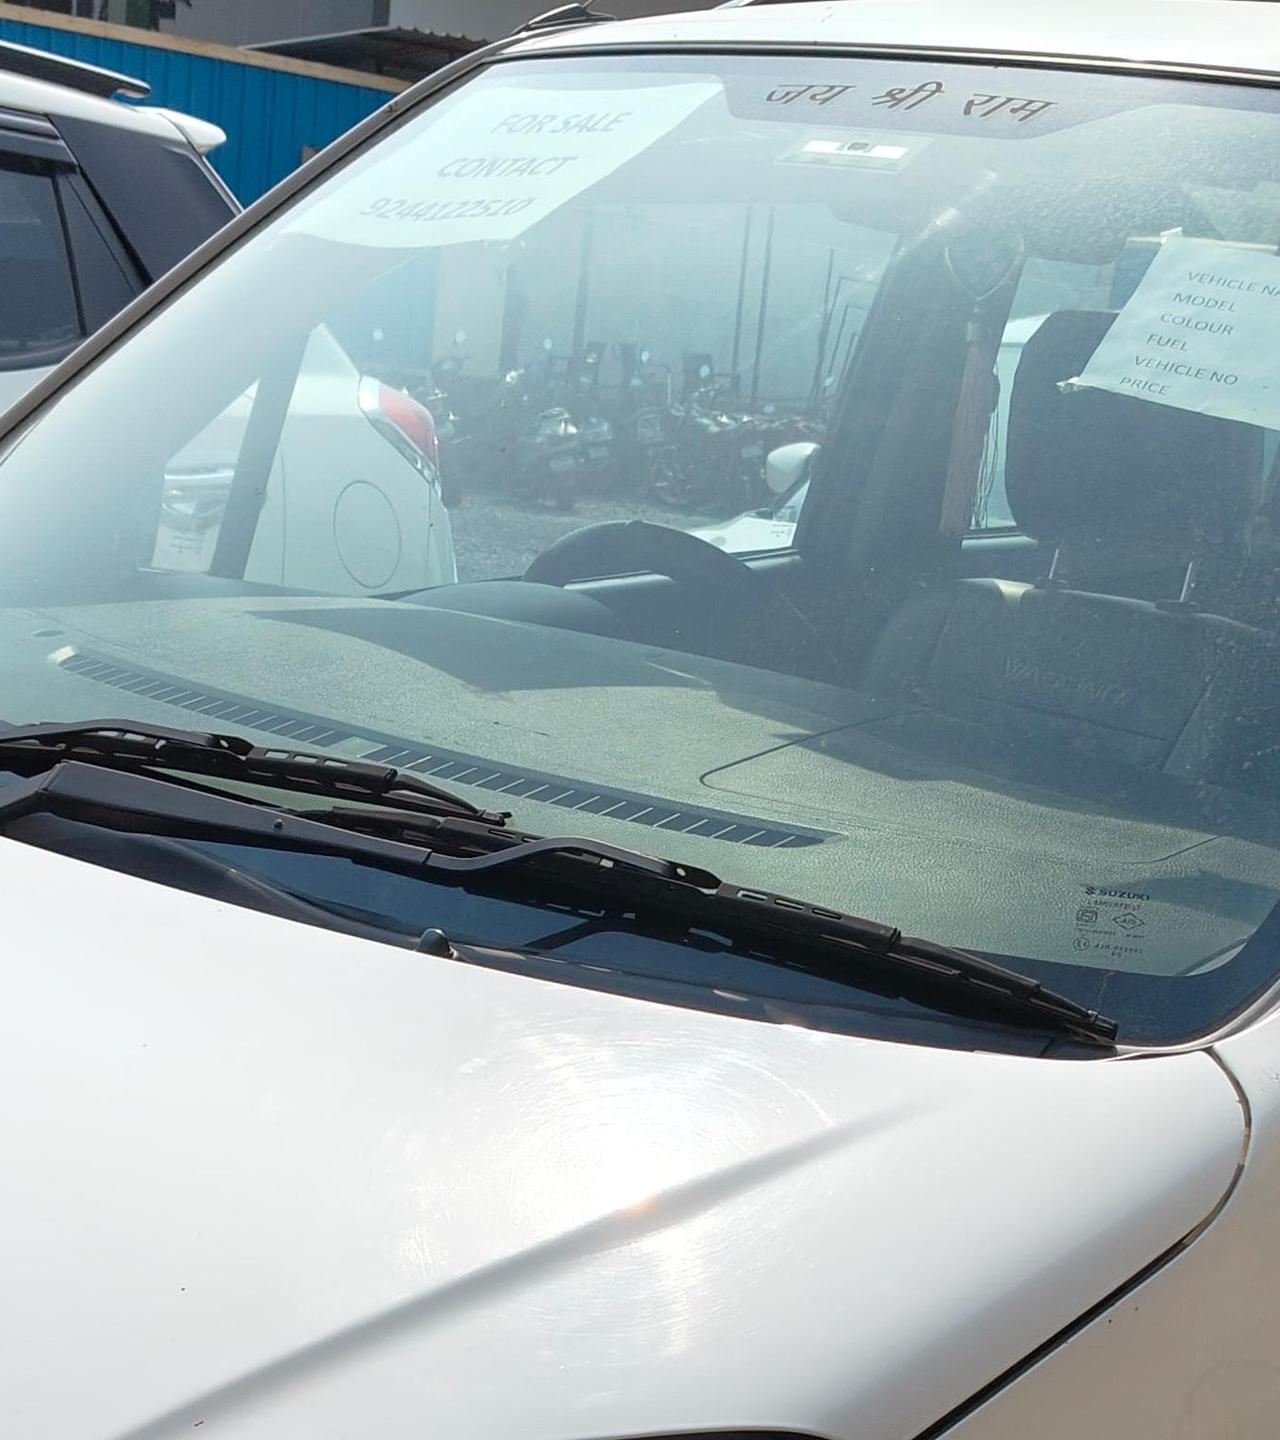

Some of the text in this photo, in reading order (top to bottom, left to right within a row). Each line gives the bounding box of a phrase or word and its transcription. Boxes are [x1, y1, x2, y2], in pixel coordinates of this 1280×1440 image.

[766, 80, 1059, 122] जय श्री राम
[489, 111, 634, 134] FOR SALE
[436, 155, 581, 179] CONTACT
[1187, 271, 1258, 292] VEHICLE
[1172, 292, 1238, 313] MODEL
[1159, 312, 1235, 336] COLOUR
[1145, 333, 1189, 352] FUEL
[1134, 355, 1207, 380] VEHICLE
[1209, 371, 1239, 386] NO
[1119, 376, 1171, 396] PRICE
[1099, 889, 1150, 901] SUZUKI
